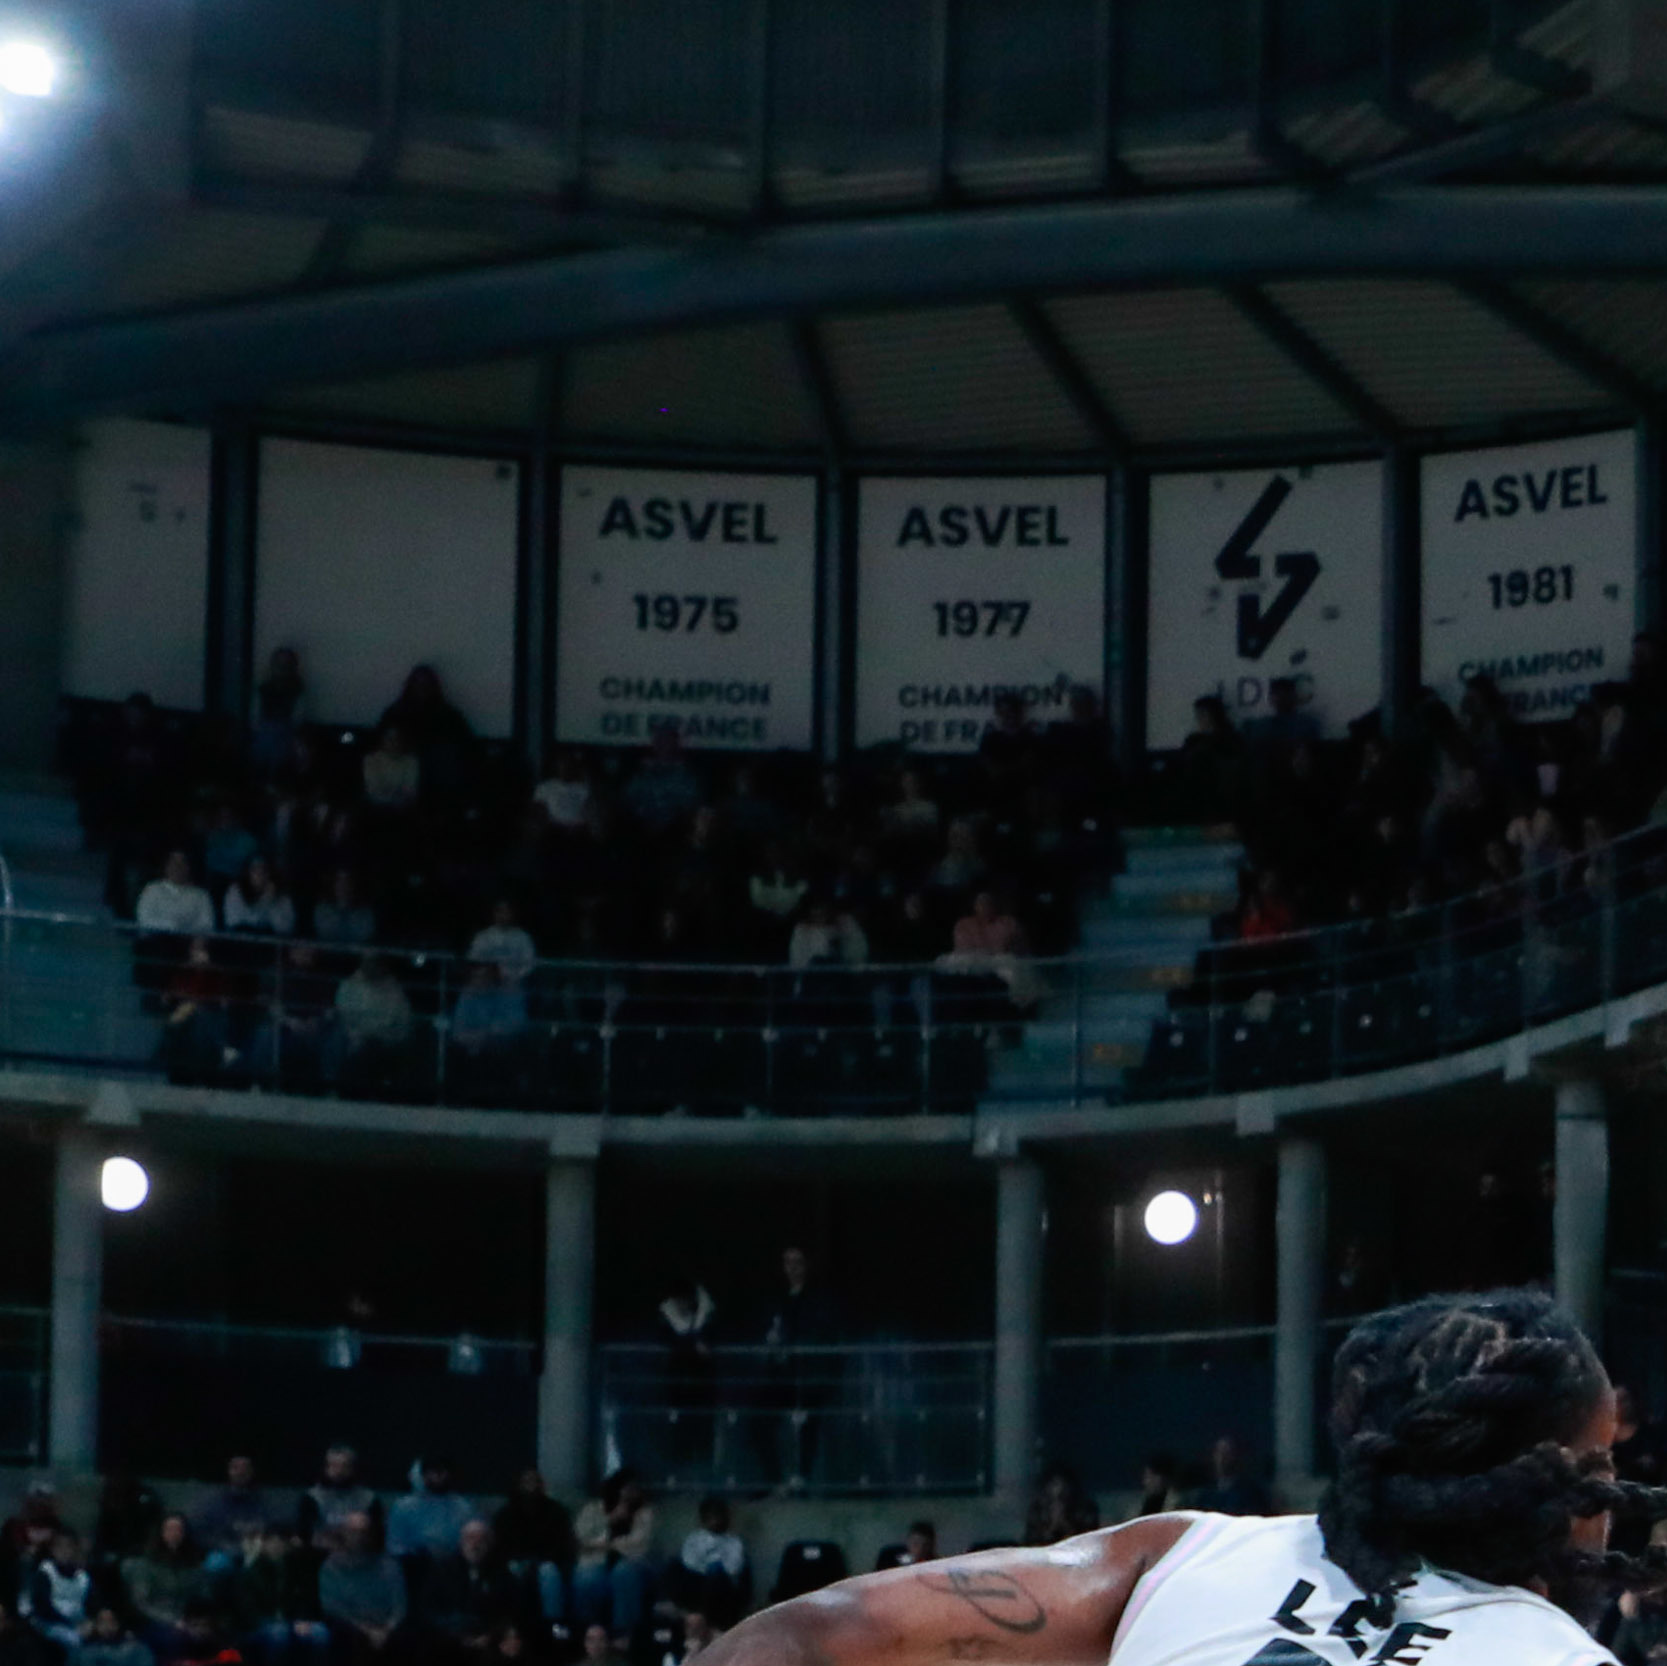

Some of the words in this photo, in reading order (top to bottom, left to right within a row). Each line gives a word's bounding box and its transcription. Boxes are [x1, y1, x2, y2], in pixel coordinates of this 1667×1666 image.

[1455, 464, 1609, 523] ASVEL
[600, 496, 778, 544] ASVEL
[897, 505, 1070, 547] ASVEL
[1487, 564, 1575, 611] 1981
[633, 593, 740, 633] 1975
[933, 600, 1031, 638] 1977
[600, 677, 771, 705] CHAMPION
[601, 712, 639, 736] DE
